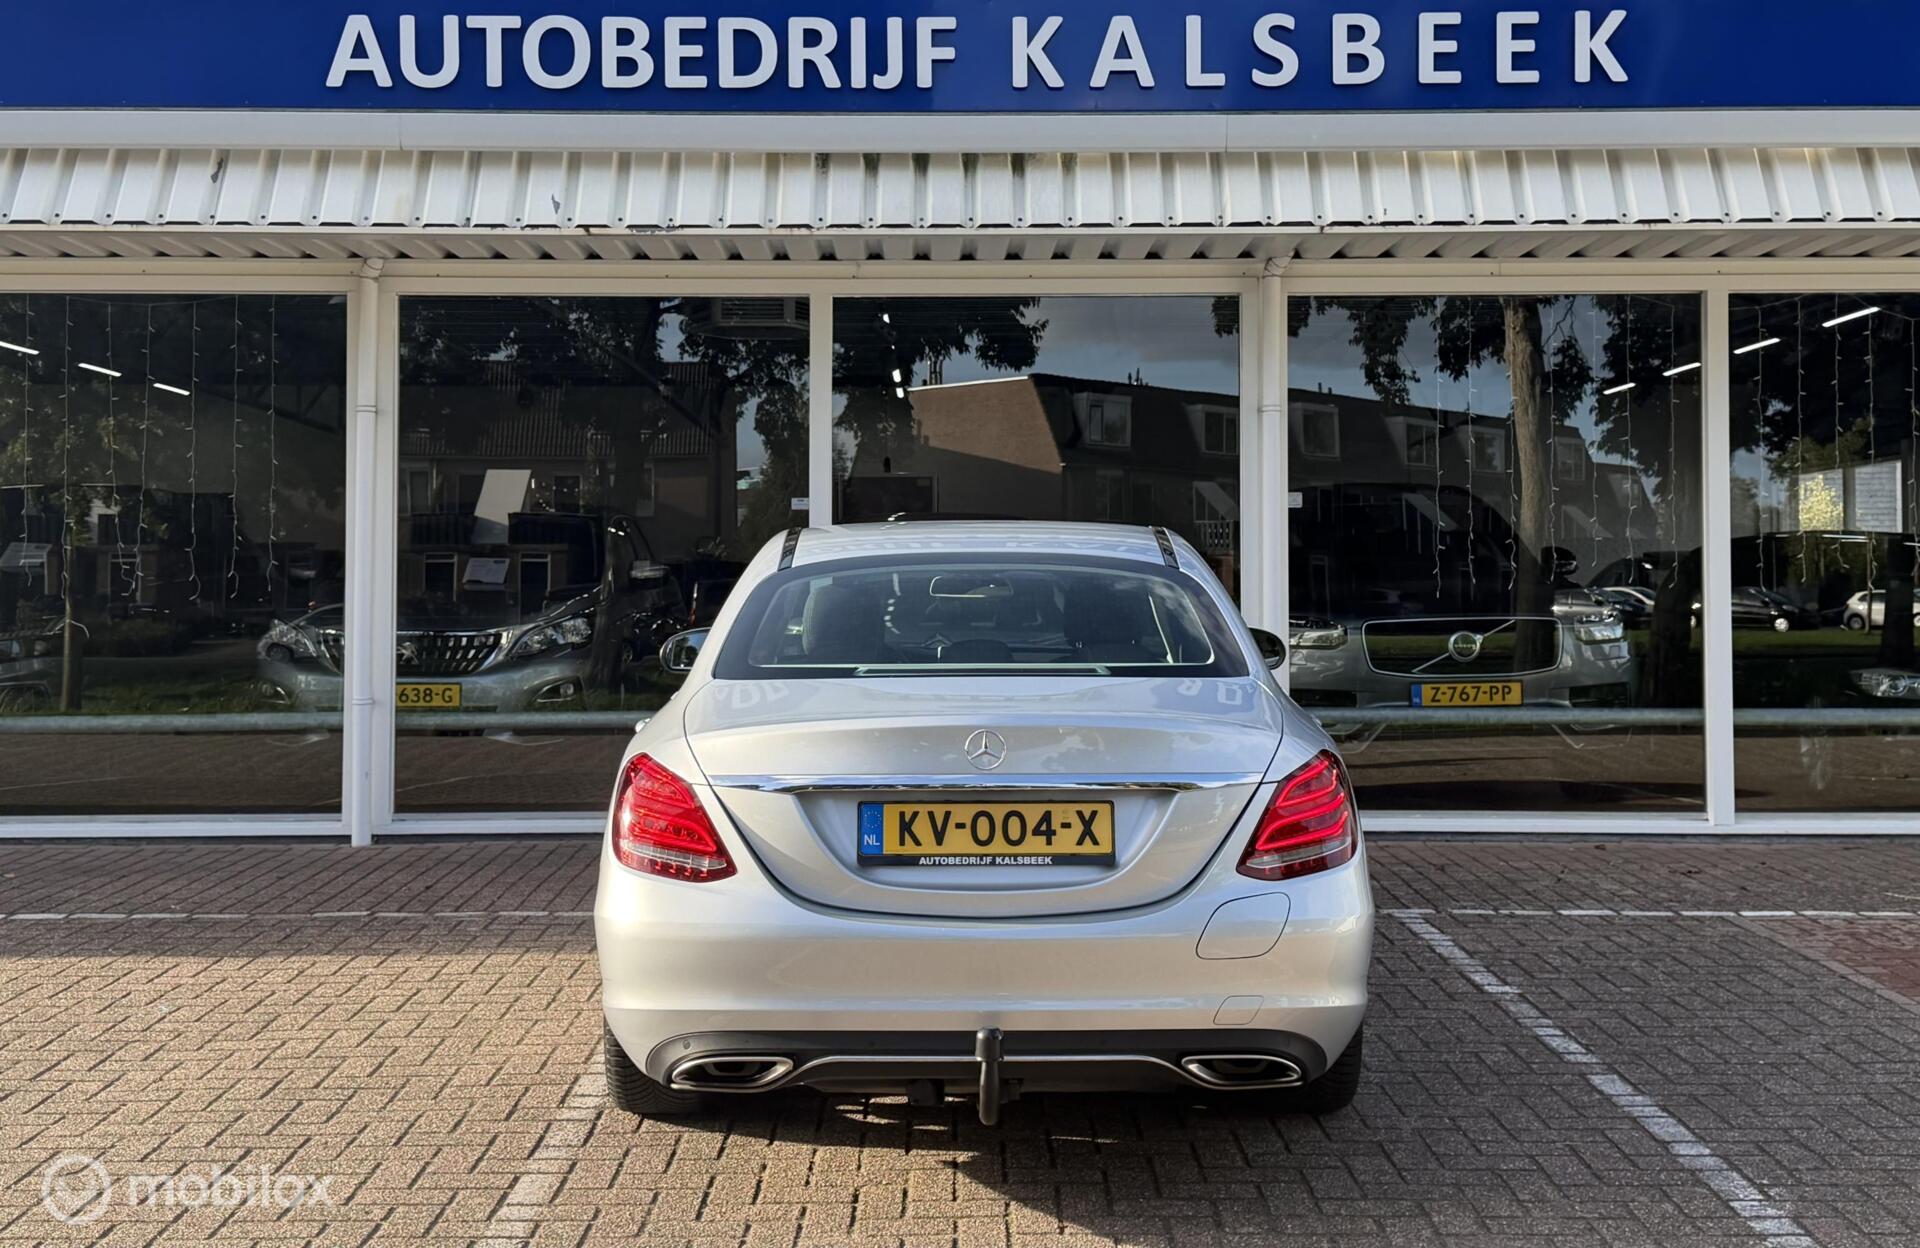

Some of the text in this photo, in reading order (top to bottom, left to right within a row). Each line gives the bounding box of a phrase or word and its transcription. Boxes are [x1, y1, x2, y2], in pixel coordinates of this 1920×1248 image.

[325, 9, 1629, 89] AUTOBEDRIJF KALSBEEK
[1430, 685, 1512, 703] Z-767-PP
[898, 810, 1100, 847] KV-004-X
[864, 834, 880, 846] NL
[918, 856, 1053, 866] AUTOBEDRIJF KALSBEEK
